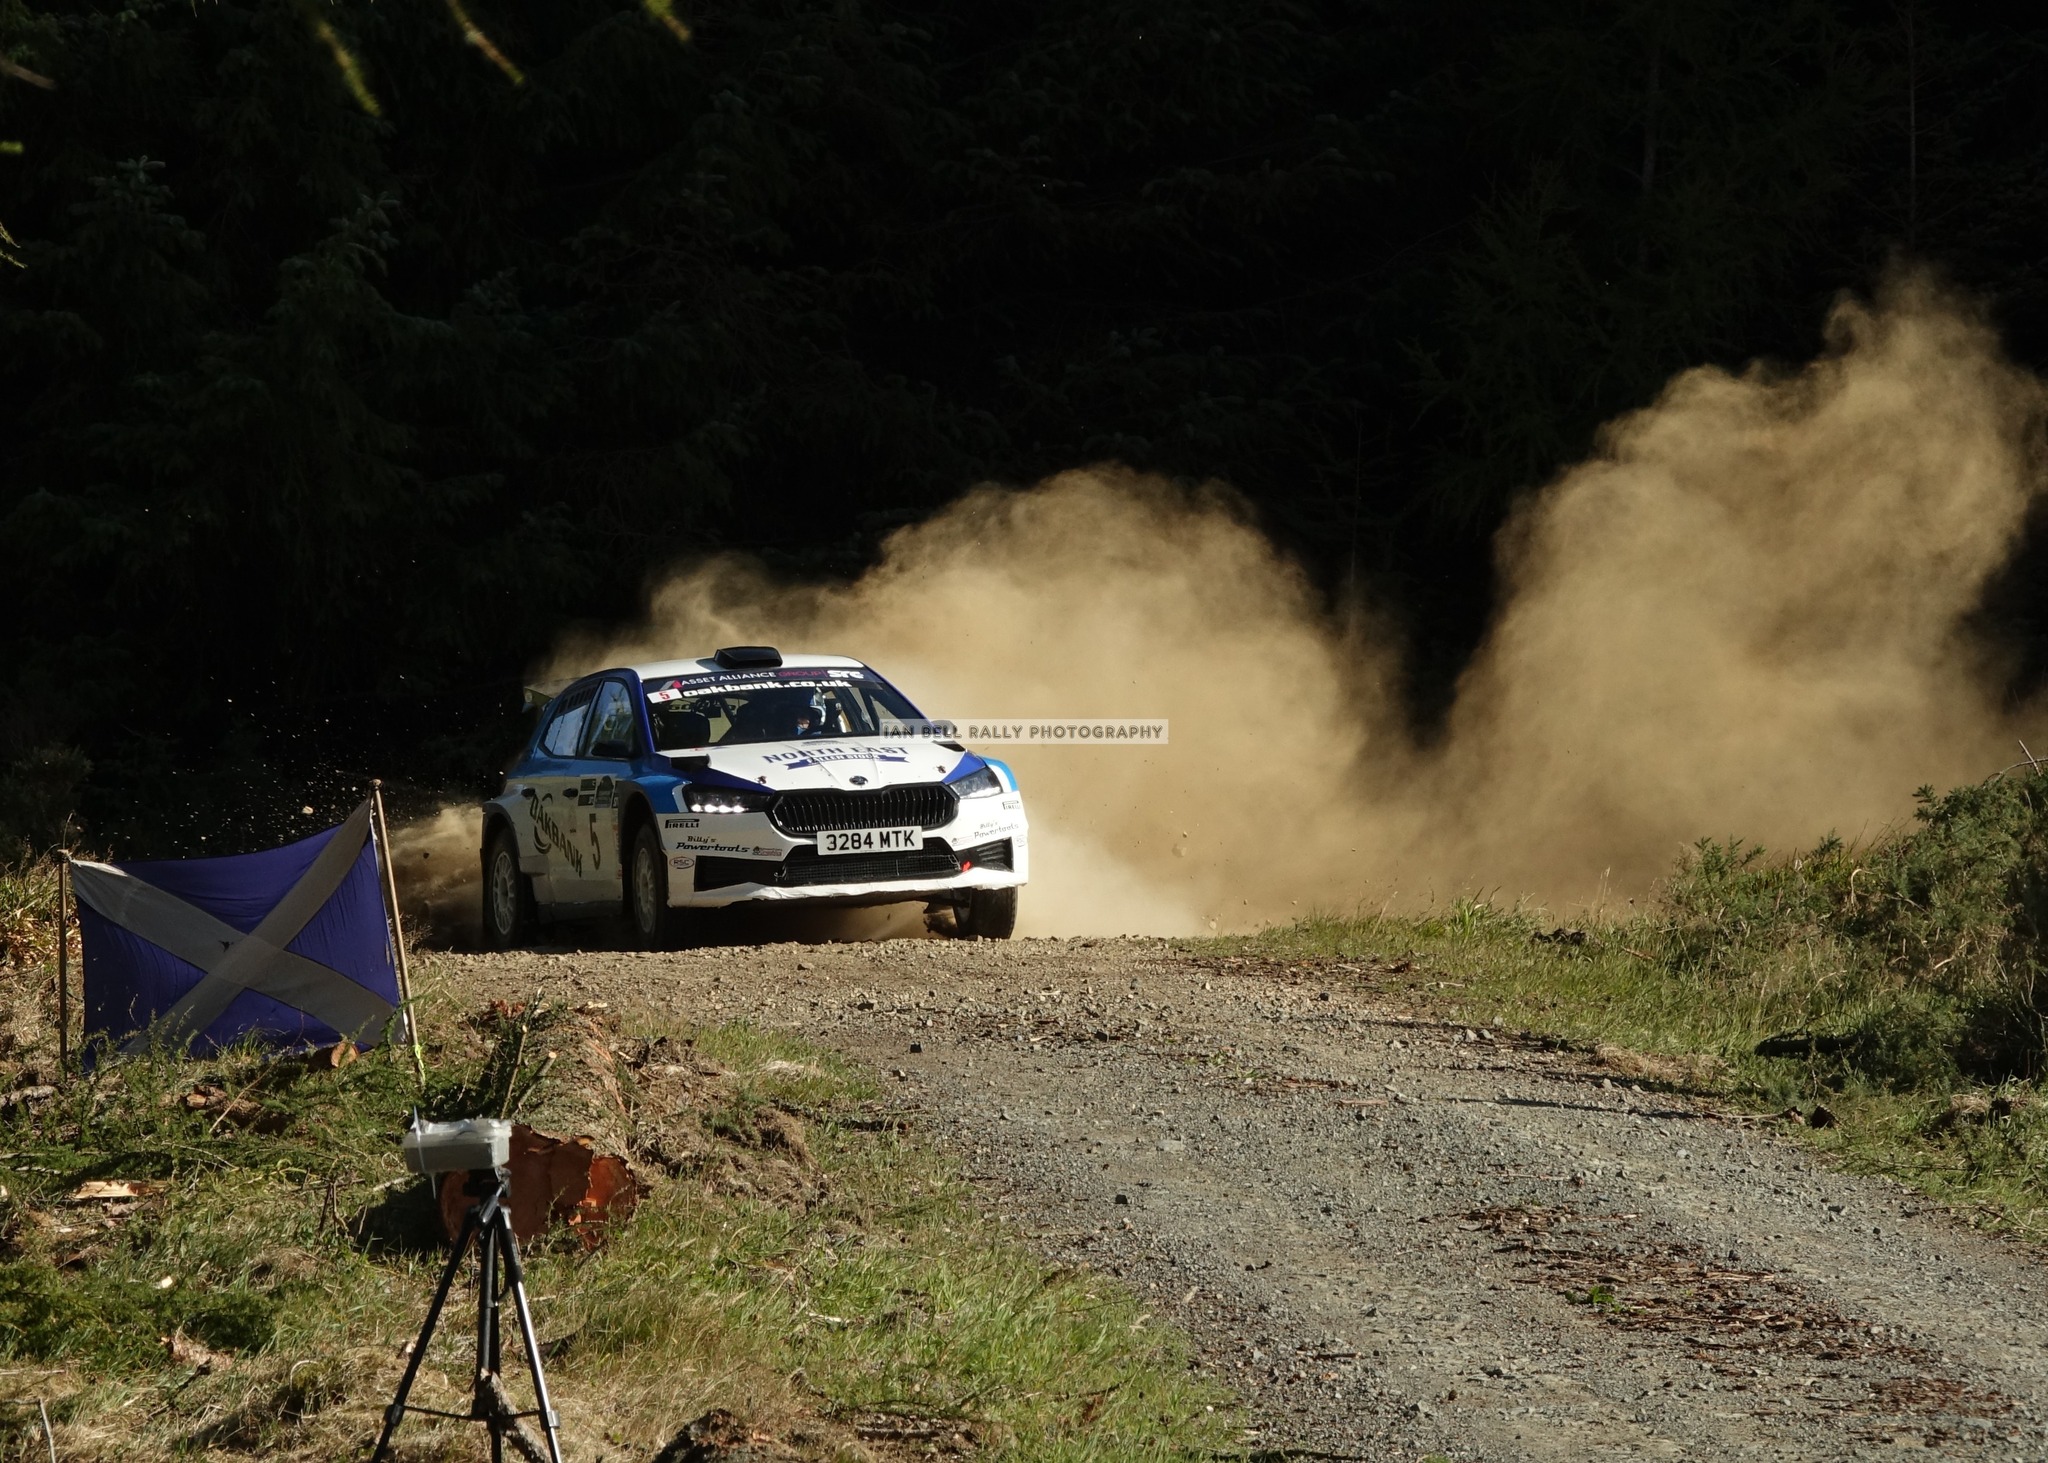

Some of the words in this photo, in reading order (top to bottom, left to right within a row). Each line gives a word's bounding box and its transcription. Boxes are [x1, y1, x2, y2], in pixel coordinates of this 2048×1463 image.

[681, 676, 716, 686] ASSET
[719, 671, 776, 682] ALLIANCE
[778, 669, 822, 678] GROUP
[659, 690, 670, 700] 5
[683, 679, 852, 698] oakbank.co.uk
[762, 747, 842, 763] NORTH
[850, 746, 909, 755] EAST
[664, 818, 700, 829] PIRELLI
[530, 793, 583, 878] OAKBANK
[589, 813, 601, 870] 5
[826, 832, 873, 851] 3284
[879, 830, 915, 848] MTK
[676, 842, 750, 853] Powertools
